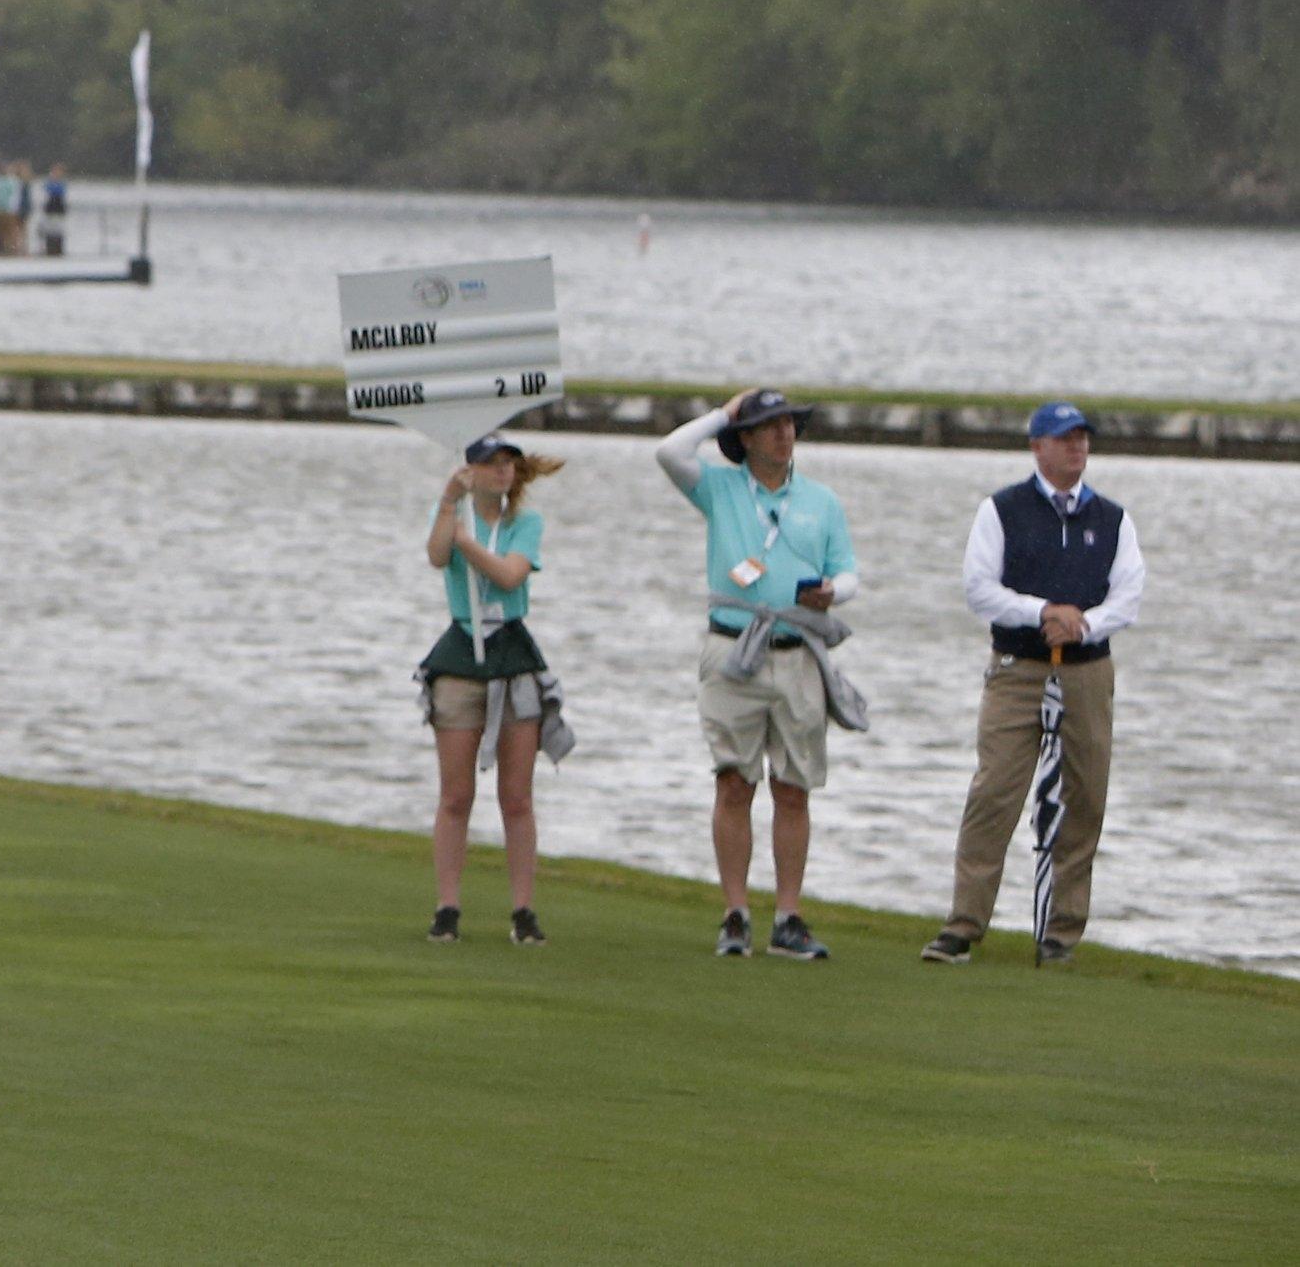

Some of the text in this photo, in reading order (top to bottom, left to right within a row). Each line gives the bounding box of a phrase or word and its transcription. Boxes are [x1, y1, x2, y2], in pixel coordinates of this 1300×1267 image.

[351, 321, 436, 350] MCILROY
[354, 371, 546, 409] WOODS 2 UP
